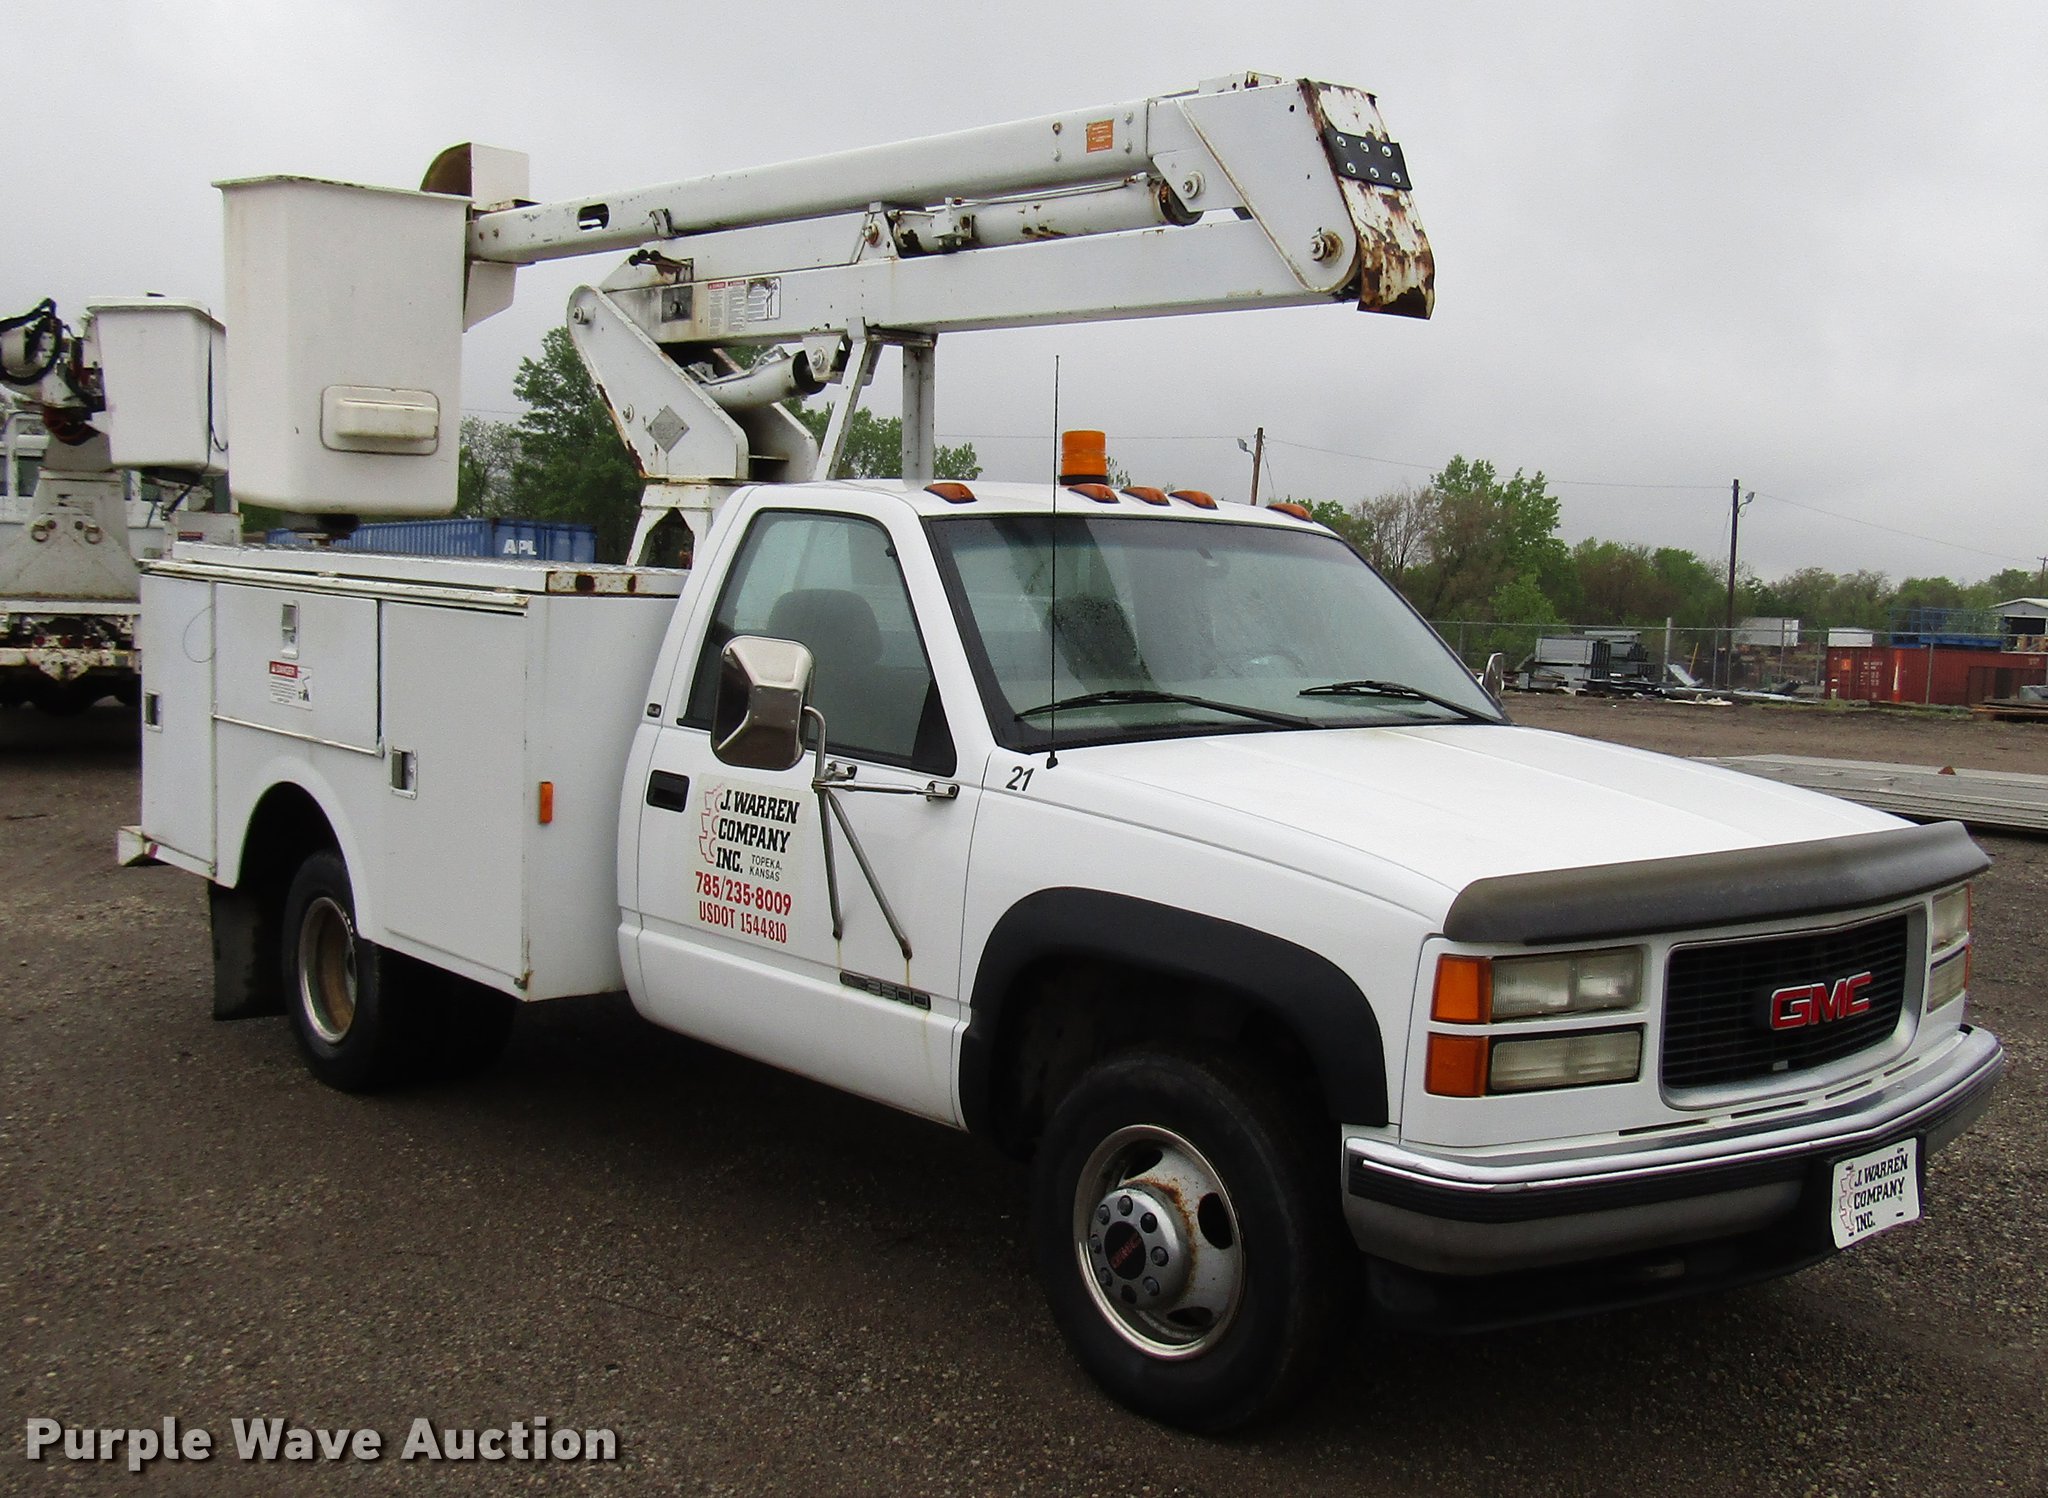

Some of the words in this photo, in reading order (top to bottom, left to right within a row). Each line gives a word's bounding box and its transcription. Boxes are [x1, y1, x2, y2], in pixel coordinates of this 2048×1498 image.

[502, 539, 537, 556] APL
[1006, 766, 1035, 791] 21
[720, 789, 732, 811] J.
[734, 791, 800, 824] WARREN
[718, 818, 791, 853] COMPANY
[716, 847, 743, 873] INC.
[749, 866, 780, 882] KANSAS
[699, 900, 735, 929] USDOT
[740, 912, 787, 943] 1544810
[1770, 971, 1872, 1030] GMC
[1864, 1153, 1908, 1183] WARREN
[1854, 1177, 1905, 1210] COMPANY
[1855, 1211, 1875, 1232] INC.
